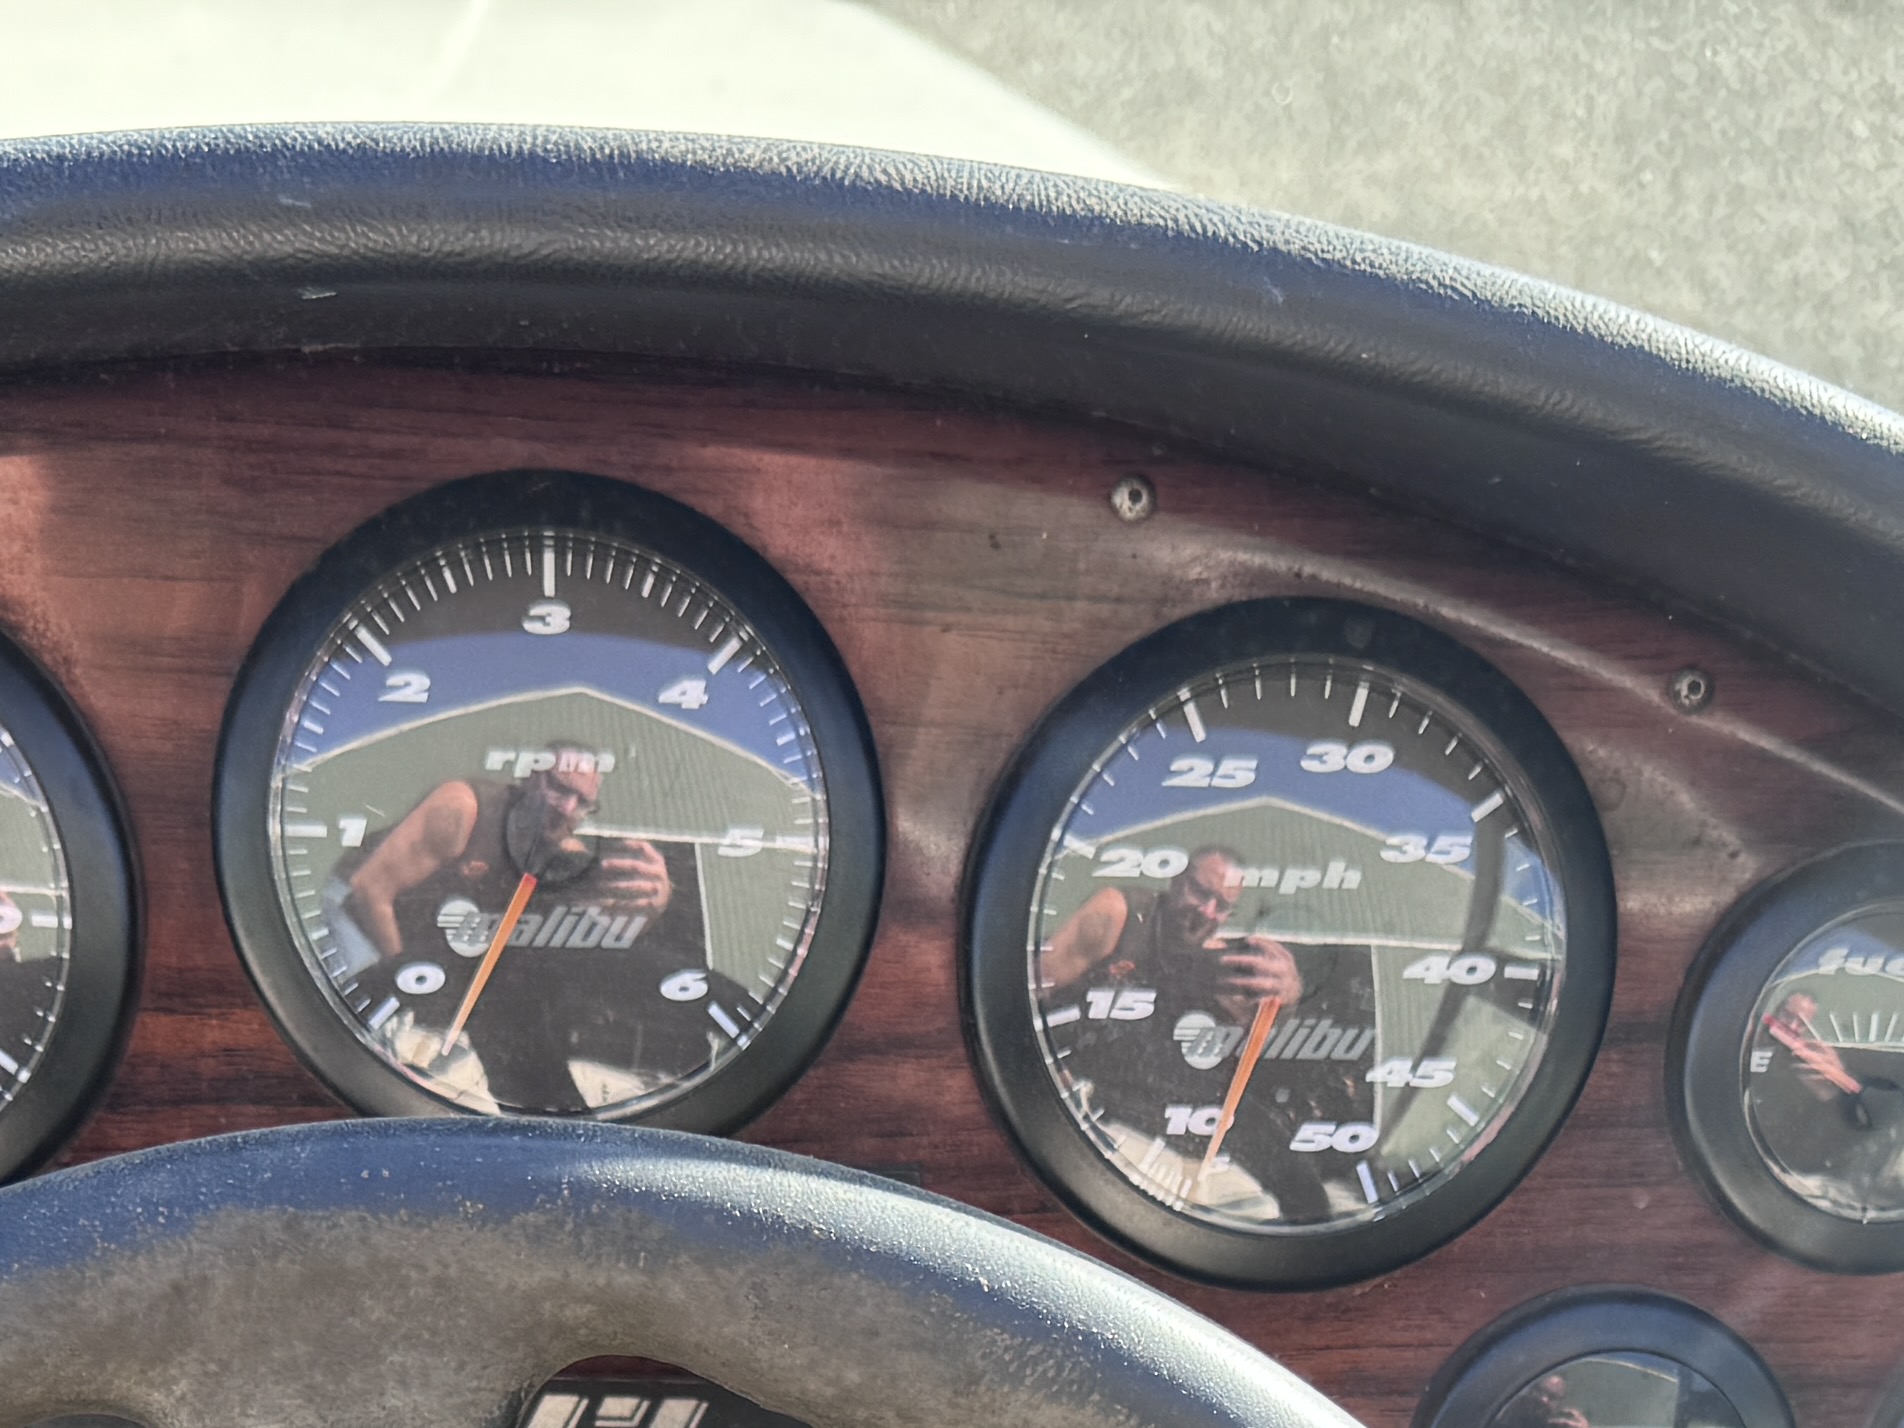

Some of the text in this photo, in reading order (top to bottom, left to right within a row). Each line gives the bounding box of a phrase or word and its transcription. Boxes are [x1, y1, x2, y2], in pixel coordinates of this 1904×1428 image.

[522, 603, 571, 634] 3
[378, 673, 431, 702] 2
[658, 680, 708, 709] 4
[485, 749, 615, 776] rpm
[1300, 743, 1395, 773] 30
[1162, 758, 1258, 788] 25
[338, 818, 368, 847] 1
[717, 827, 764, 857] 5
[1092, 849, 1188, 878] 20
[1380, 836, 1472, 864] 35
[1224, 860, 1362, 894] mph
[468, 907, 650, 949] malibu
[396, 963, 445, 995] 0
[1403, 956, 1496, 984] 40
[660, 971, 708, 1000] 6
[1086, 990, 1157, 1020] 15
[1366, 1060, 1456, 1088] 45
[1750, 1051, 1774, 1073] E
[1164, 1106, 1234, 1135] 10
[1290, 1123, 1381, 1151] 50
